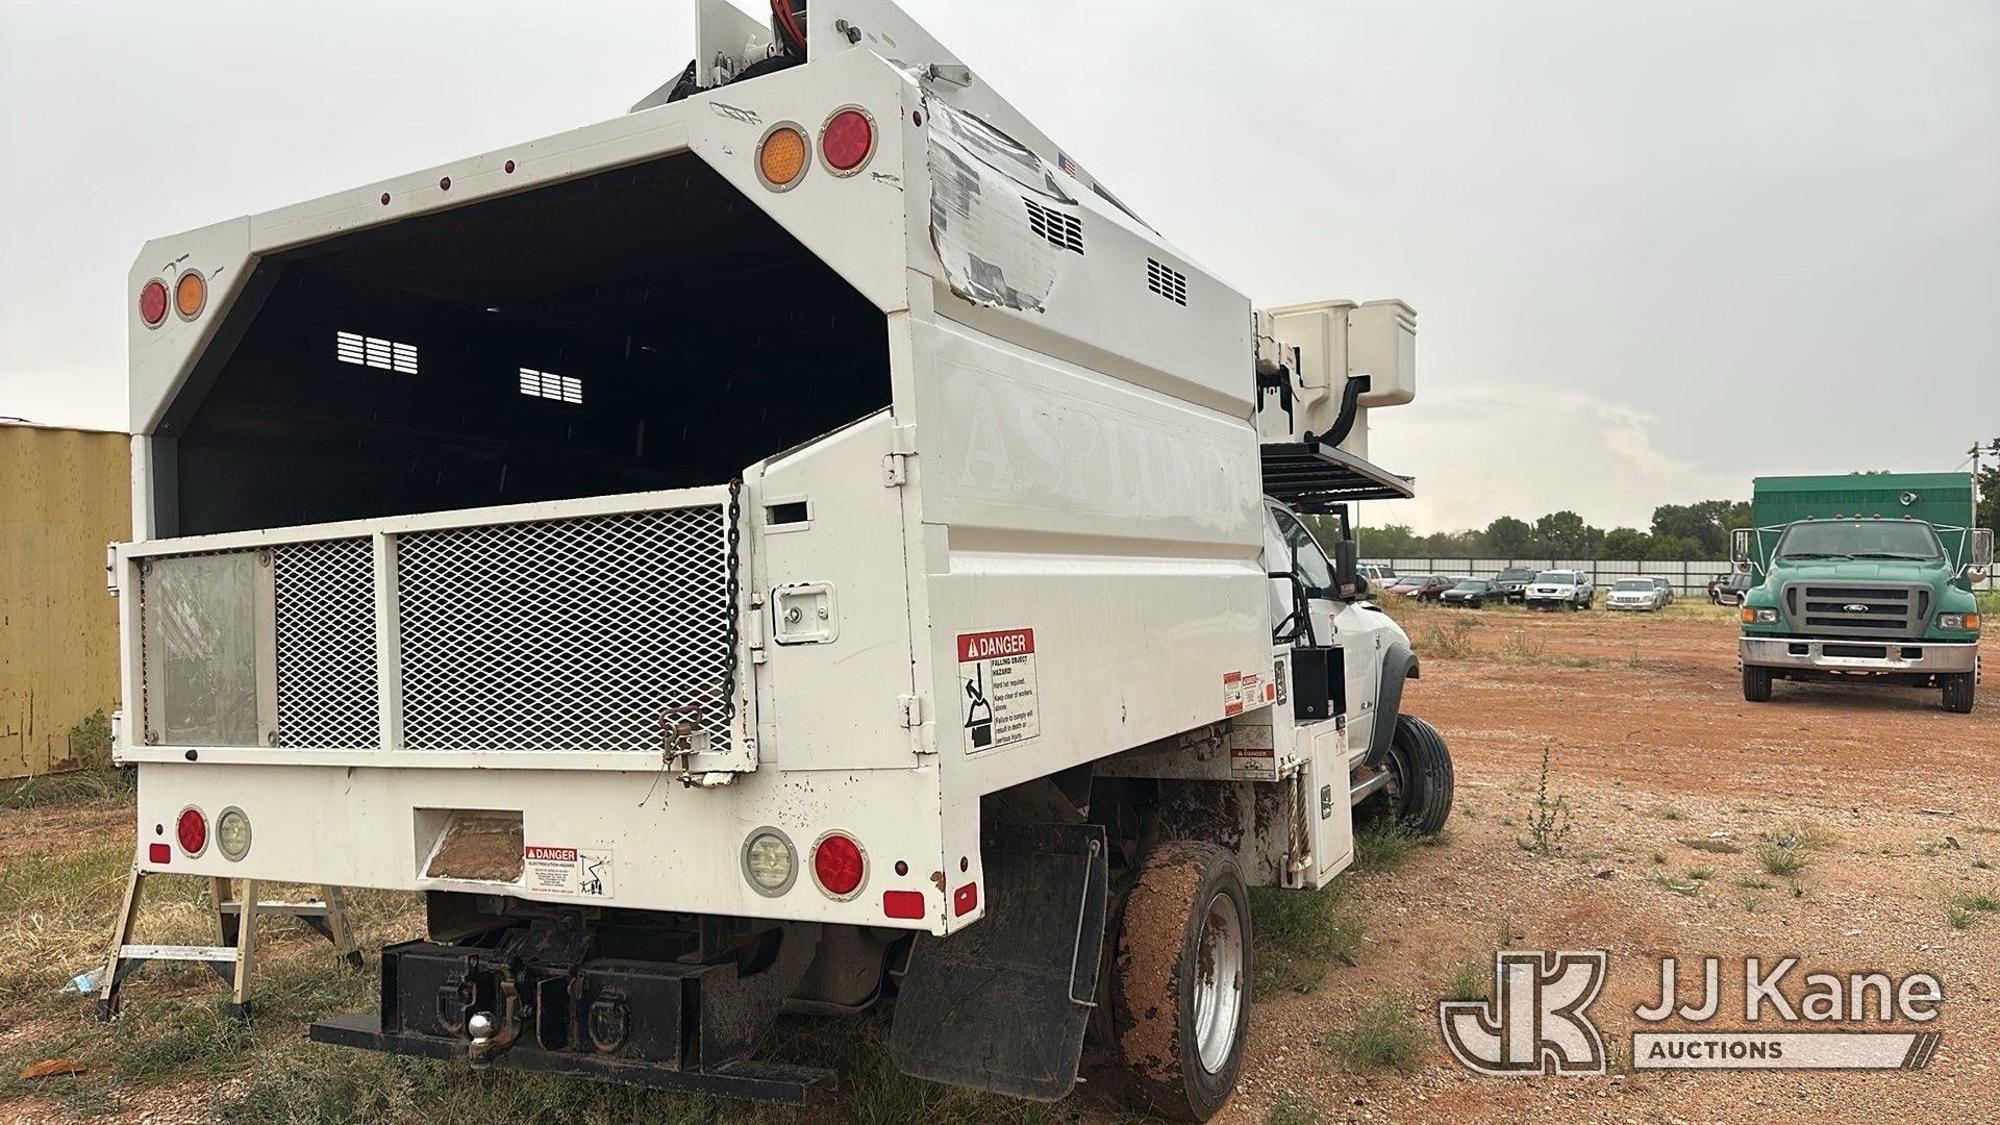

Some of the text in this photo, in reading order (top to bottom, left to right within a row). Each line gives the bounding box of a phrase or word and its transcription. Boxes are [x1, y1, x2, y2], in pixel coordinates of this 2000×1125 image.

[980, 634, 1026, 657] DANGER
[991, 655, 1028, 666] FALLING OBJECT
[536, 849, 575, 860] DANGER
